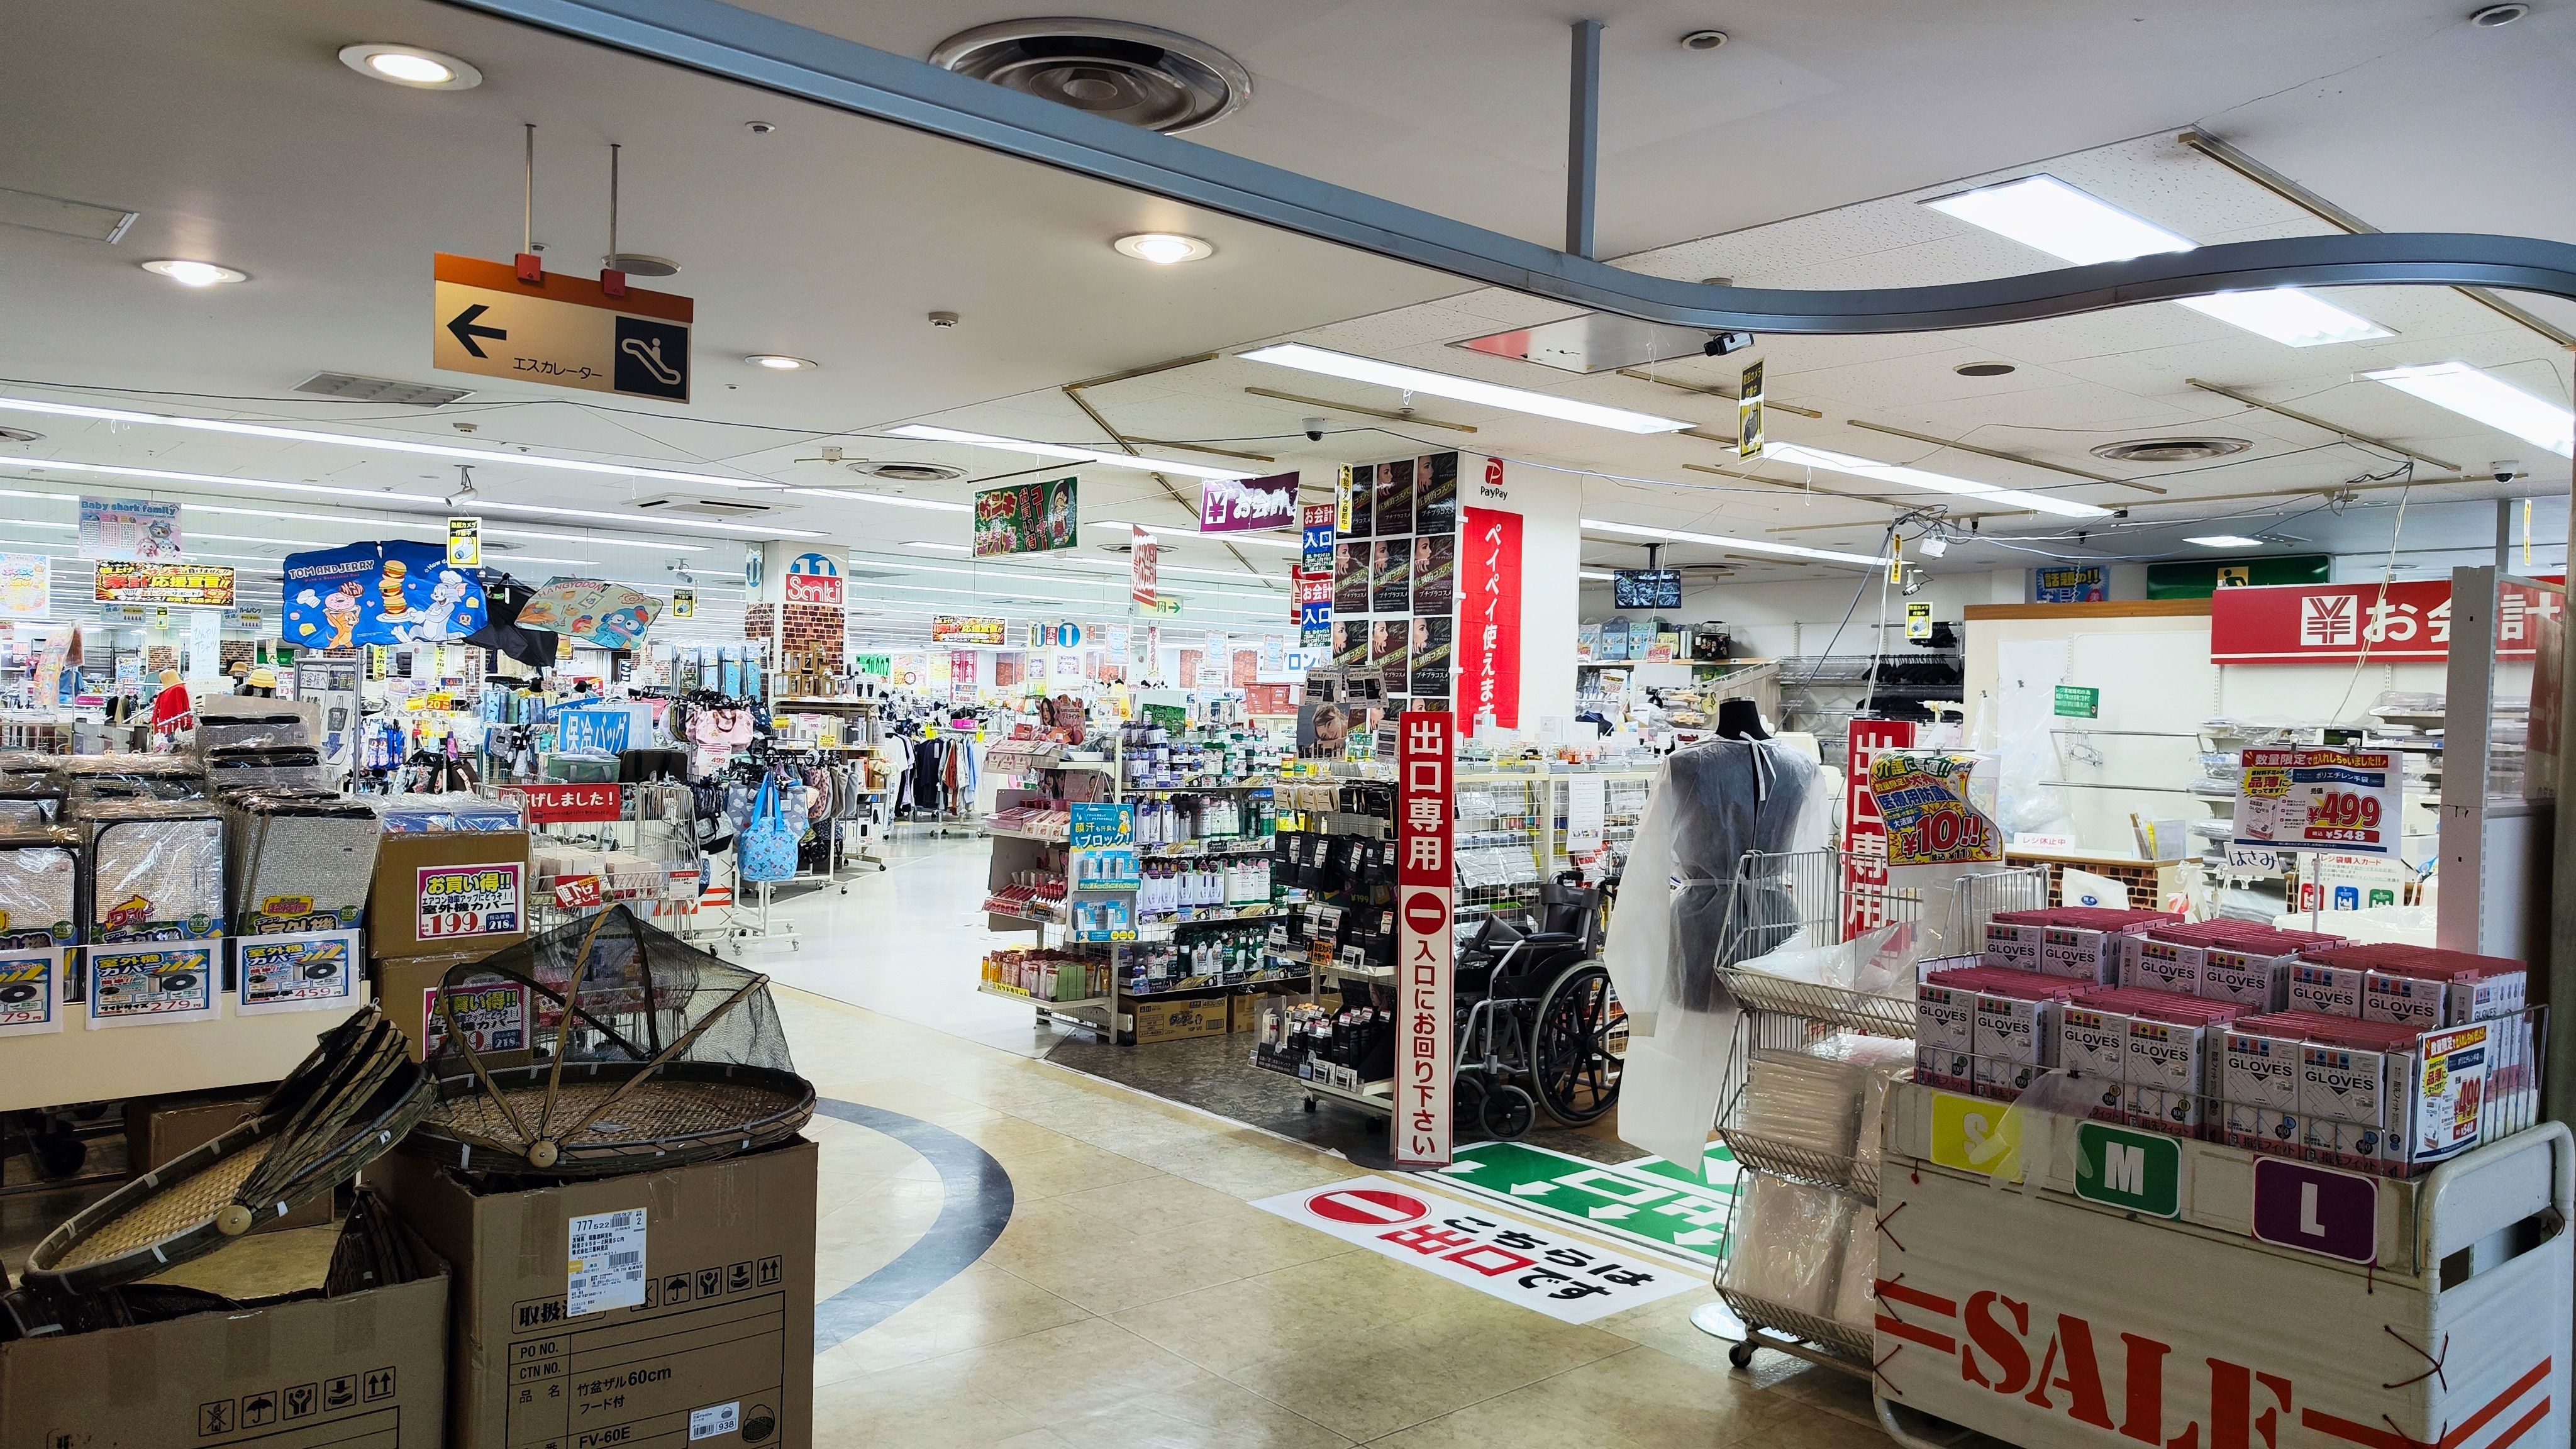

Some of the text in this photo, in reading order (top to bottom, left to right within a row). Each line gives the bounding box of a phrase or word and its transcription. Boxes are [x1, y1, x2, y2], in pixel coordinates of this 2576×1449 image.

[513, 357, 602, 380] エスカレーター
[1743, 367, 1762, 385] 防犯カメラ
[1746, 386, 1758, 397] 作動中
[1480, 486, 1508, 502] PayPay
[80, 501, 179, 516] Baby shark family
[979, 491, 1017, 521] サンキ
[1019, 487, 1037, 552] お買い得
[1031, 484, 1048, 551] コーナー
[1304, 505, 1335, 526] お会計
[1304, 530, 1333, 549] 入口
[289, 568, 315, 580] TOM
[316, 564, 340, 575] AND
[338, 559, 375, 573] JERRY
[2045, 568, 2101, 587] 話題の!!
[103, 575, 231, 589] 家計応援宣言!!
[538, 581, 604, 598] HANGYODON
[787, 575, 841, 603] Sanki
[1302, 582, 1333, 601] お会計
[1302, 607, 1332, 625] 入口
[193, 628, 217, 639] ひんやり
[194, 640, 218, 656] Tシャツ
[301, 672, 328, 689] お客様へ
[328, 670, 355, 689] カゴ置場
[445, 678, 461, 686] SALE
[427, 700, 440, 709] 20
[565, 712, 628, 755] 保冷バッグ
[2248, 776, 2289, 789] 品薄に
[2315, 772, 2369, 784] ポリエチレン手袋
[1408, 721, 1445, 871] 出口専用
[2306, 791, 2382, 828] ¥499
[1081, 833, 1130, 848] ブロック!
[2023, 836, 2067, 846] レジ休止中
[2325, 829, 2366, 841] ¥548
[2228, 850, 2279, 870] はさみ
[2321, 855, 2382, 866] レジ袋購入カード
[427, 872, 511, 895] お買い得!!
[555, 880, 594, 903] 値下げ
[422, 900, 514, 915] 室外機カバー
[565, 894, 600, 908] しました
[1351, 893, 1370, 904] ¥199
[257, 917, 279, 926] エアコン
[105, 931, 126, 941] エアコン
[248, 943, 304, 957] 室外機
[248, 953, 306, 965] カバー
[1988, 943, 2035, 957] GLOVES
[2045, 948, 2096, 963] GLOVES
[98, 953, 160, 968] 室外機
[100, 963, 164, 977] カバー
[2141, 962, 2196, 979] GLOVES
[2206, 971, 2265, 990] GLOVES
[435, 991, 518, 1014] 買い得!!
[2293, 987, 2354, 1006] GLOVES
[101, 1002, 148, 1011] ワイドサイズ
[1919, 1005, 1968, 1023] GLOVES
[2368, 997, 2434, 1018] GLOVES
[1978, 1017, 2030, 1033] GLOVES
[1413, 940, 1437, 1156] 入口にお回り下さい
[2065, 1030, 2120, 1048] GLOVES
[2131, 1042, 2189, 1062] GLOVES
[2228, 1057, 2293, 1077] GLOVES
[2305, 1071, 2375, 1091] GLOVES
[2105, 1141, 2145, 1196] M
[2299, 1182, 2326, 1237] L
[1443, 1215, 1657, 1288] こちらは
[520, 1341, 559, 1359] PO NO.
[519, 1361, 561, 1380] CTN NO.
[1962, 1289, 2293, 1449] SALE
[579, 1395, 626, 1415] フード付
[718, 1421, 735, 1432] 938
[579, 1426, 631, 1448] FV-60E
